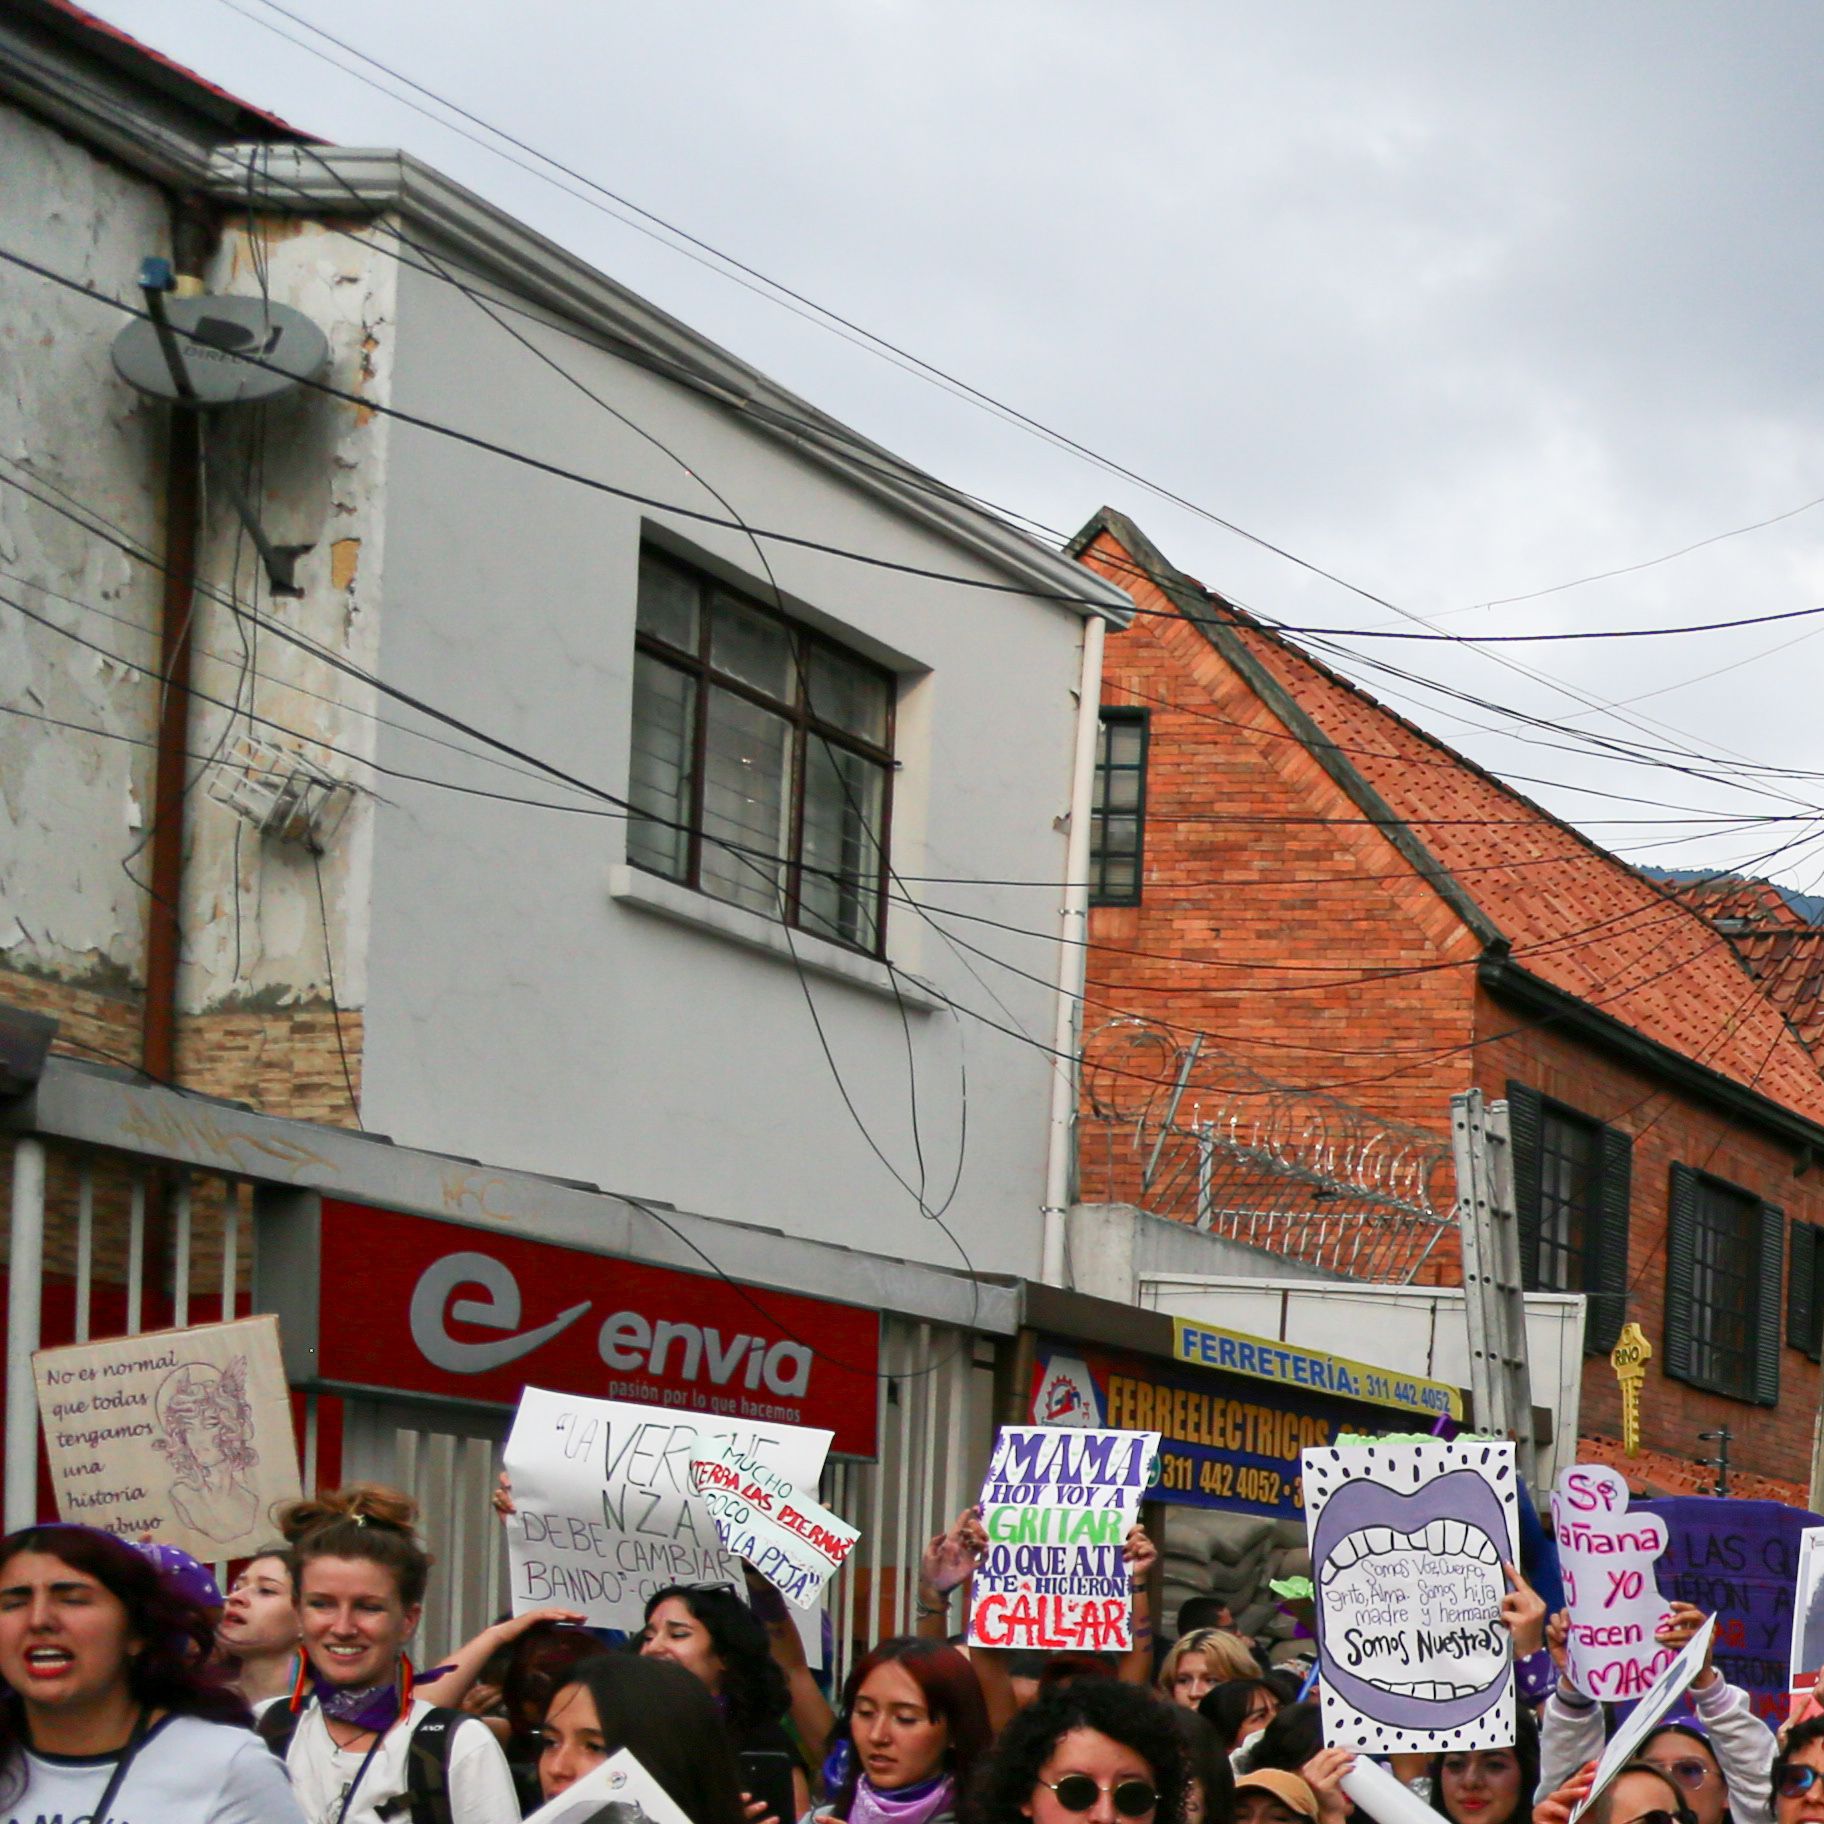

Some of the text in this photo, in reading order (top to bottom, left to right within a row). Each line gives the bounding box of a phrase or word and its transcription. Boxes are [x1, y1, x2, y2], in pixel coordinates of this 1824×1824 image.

[47, 1369, 71, 1386] No
[103, 1350, 178, 1377] normal
[1182, 1327, 1451, 1414] FERRETERÍA: 311 442 4052
[52, 1391, 149, 1419] que todas
[664, 1388, 688, 1407] por
[692, 1389, 706, 1406] lo
[711, 1396, 737, 1415] que
[741, 1396, 801, 1423] hacemos
[1107, 1373, 1329, 1462] FERREELECTRICOS
[56, 1422, 153, 1449] tengamos
[63, 1461, 104, 1478] una
[722, 1446, 793, 1498] MUCHO
[994, 1433, 1150, 1487] MAMÁ
[66, 1486, 146, 1509] historia
[741, 1482, 774, 1511] LAS
[989, 1485, 1125, 1508] HOY VOY A
[1162, 1454, 1280, 1506] 311 442 4052
[522, 1511, 607, 1558] DEBE
[988, 1505, 1124, 1546] GRITAR
[616, 1540, 741, 1582] CAMBIAR
[1015, 1545, 1068, 1577] QUE
[1361, 1558, 1410, 1585] Somos
[983, 1575, 1126, 1597] TE HICIERON
[1417, 1579, 1456, 1606] Somos
[1463, 1578, 1497, 1606] hija
[975, 1594, 1128, 1651] CALLAR
[1356, 1602, 1501, 1627] madre y hermana
[1344, 1628, 1410, 1666] Somos
